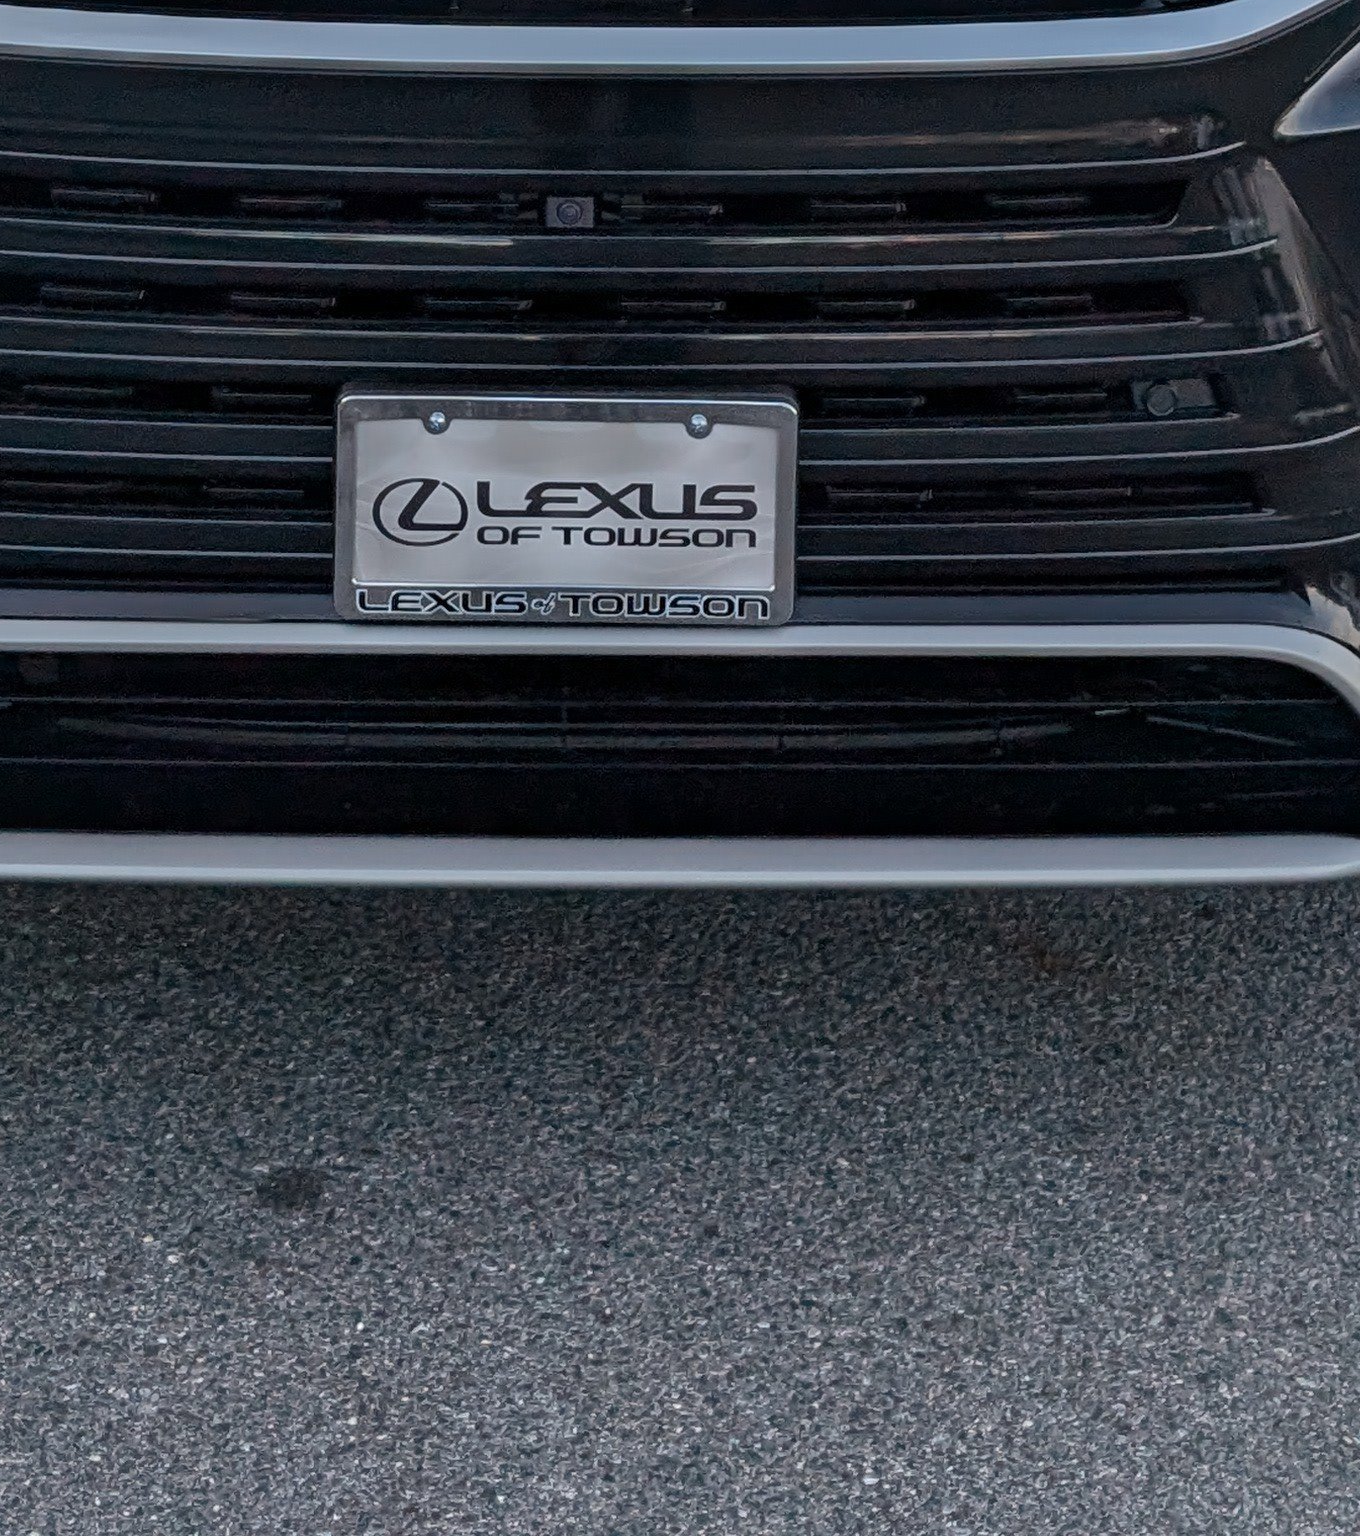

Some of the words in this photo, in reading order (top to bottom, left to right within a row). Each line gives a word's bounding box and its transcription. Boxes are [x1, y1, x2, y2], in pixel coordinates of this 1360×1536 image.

[476, 480, 758, 521] LEXUS
[476, 525, 542, 545] OF
[551, 526, 757, 548] TOWSON
[355, 588, 528, 615] LEXUS
[531, 592, 556, 614] of
[557, 591, 770, 620] TOWSON
